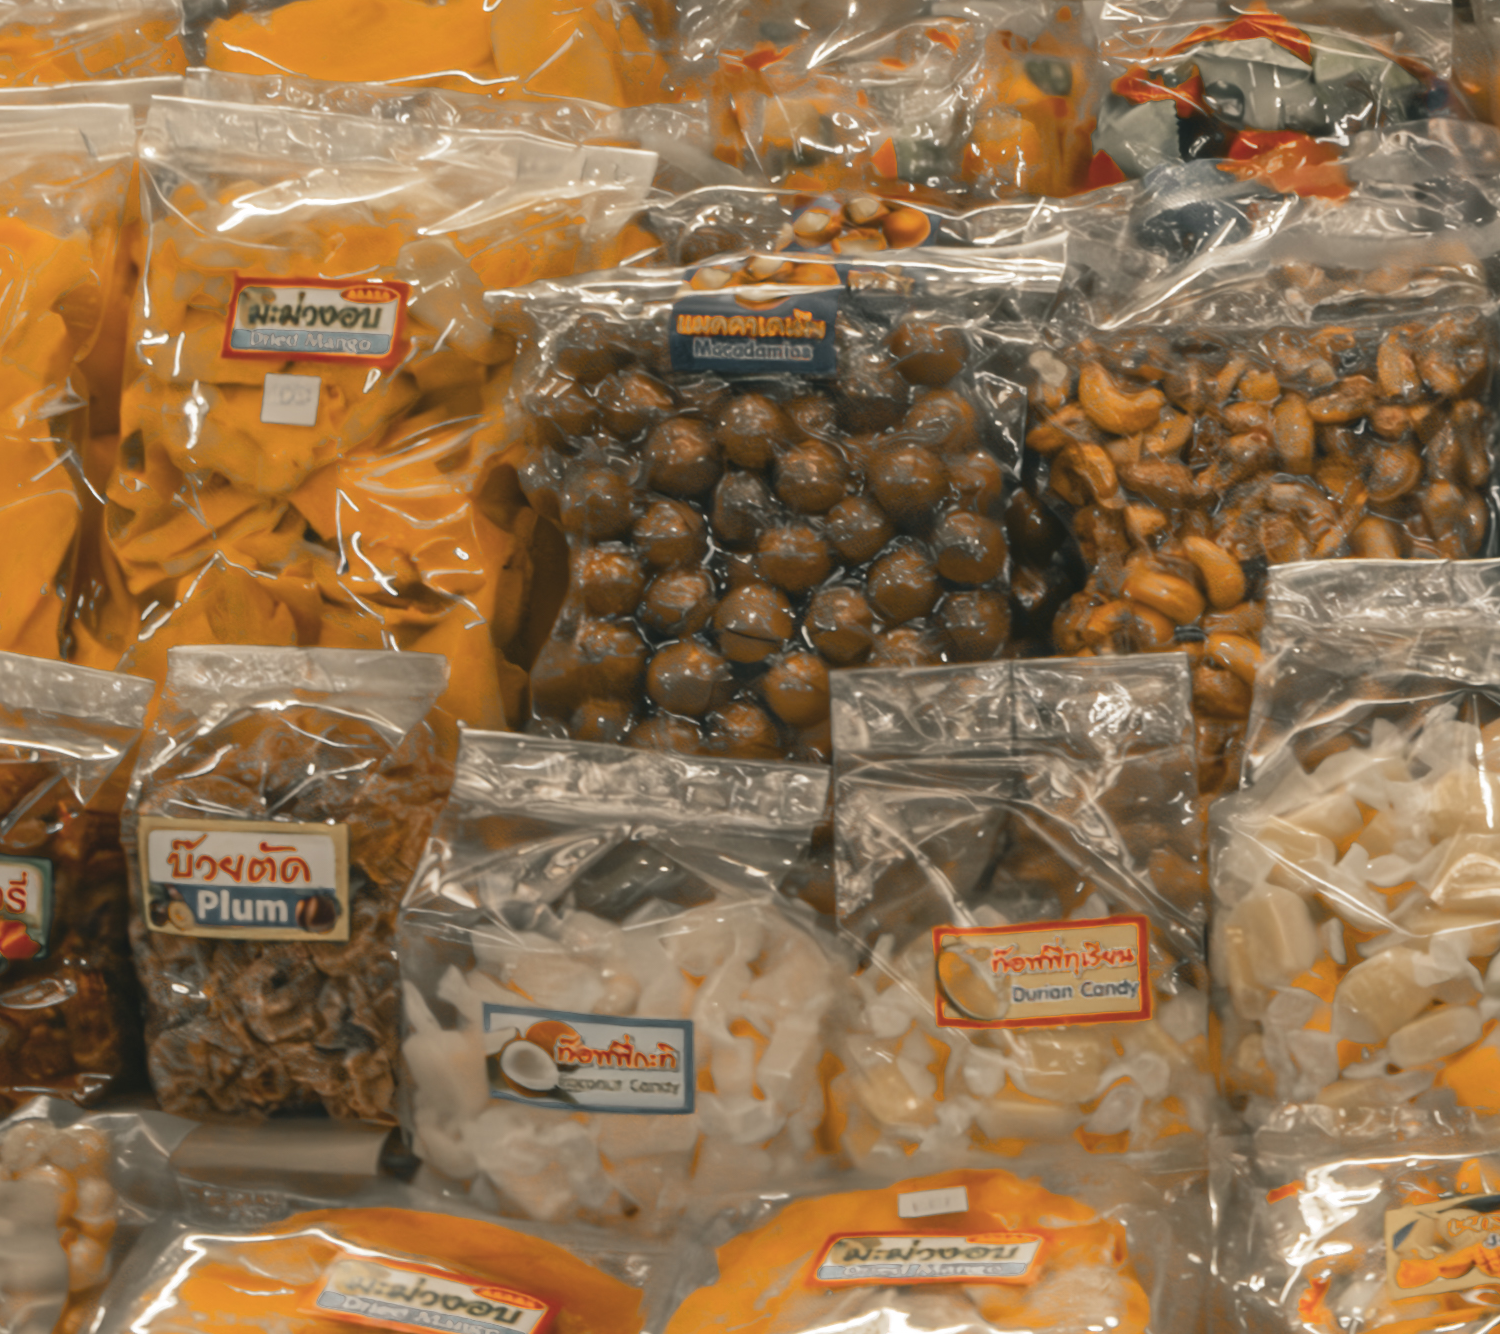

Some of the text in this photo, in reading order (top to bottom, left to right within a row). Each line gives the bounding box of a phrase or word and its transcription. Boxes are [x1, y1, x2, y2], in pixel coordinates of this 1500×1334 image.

[248, 297, 384, 331] มะม่วงอบ
[306, 333, 372, 359] Mango
[168, 839, 312, 883] บ๊วยตัด
[196, 889, 290, 925] Plum
[1012, 979, 1140, 1003] Durian Candy
[630, 1075, 680, 1097] Candy
